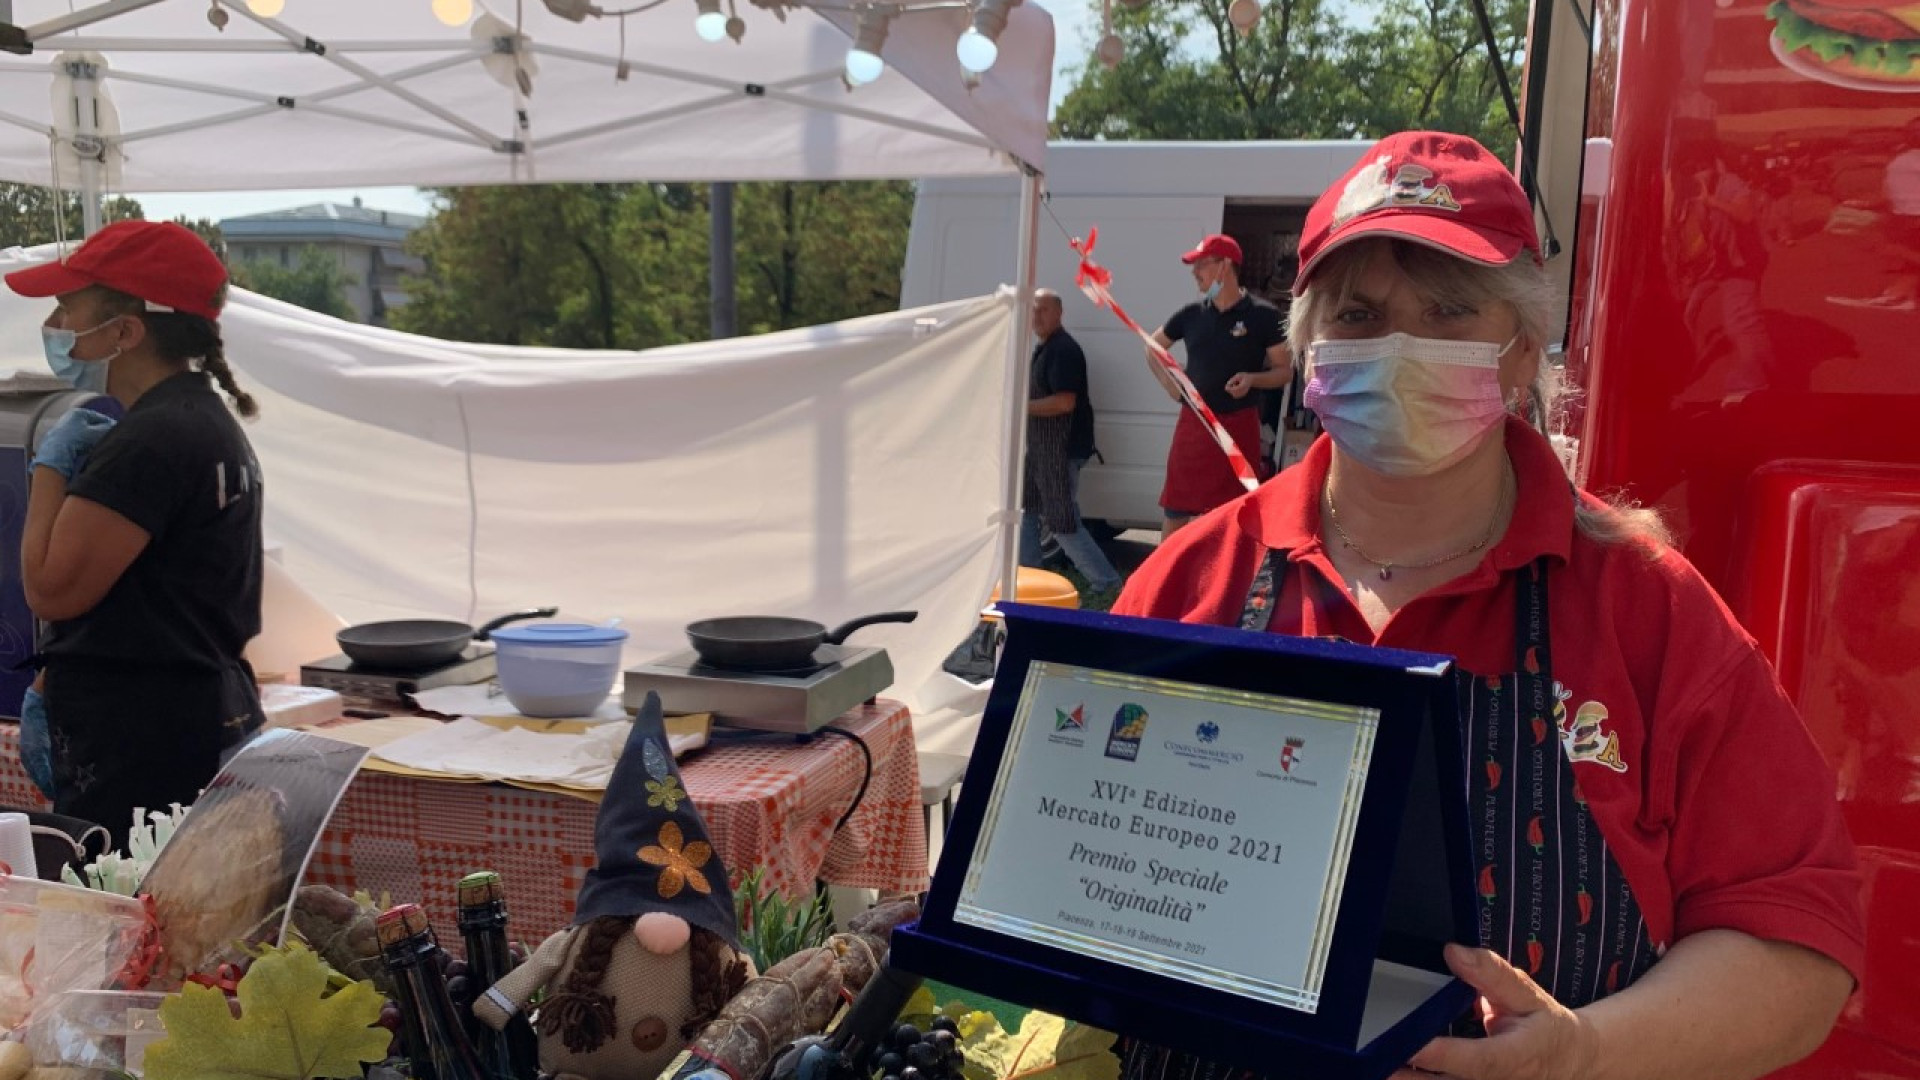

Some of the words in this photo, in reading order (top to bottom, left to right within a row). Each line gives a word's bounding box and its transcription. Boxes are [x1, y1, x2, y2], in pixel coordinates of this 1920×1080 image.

[1037, 796, 1121, 830] Mercato
[1128, 814, 1219, 851] Europeo
[1227, 835, 1283, 865] 2021
[1142, 789, 1237, 826] Edizione
[1068, 841, 1137, 874] Premio
[1144, 858, 1229, 895] Speciale
